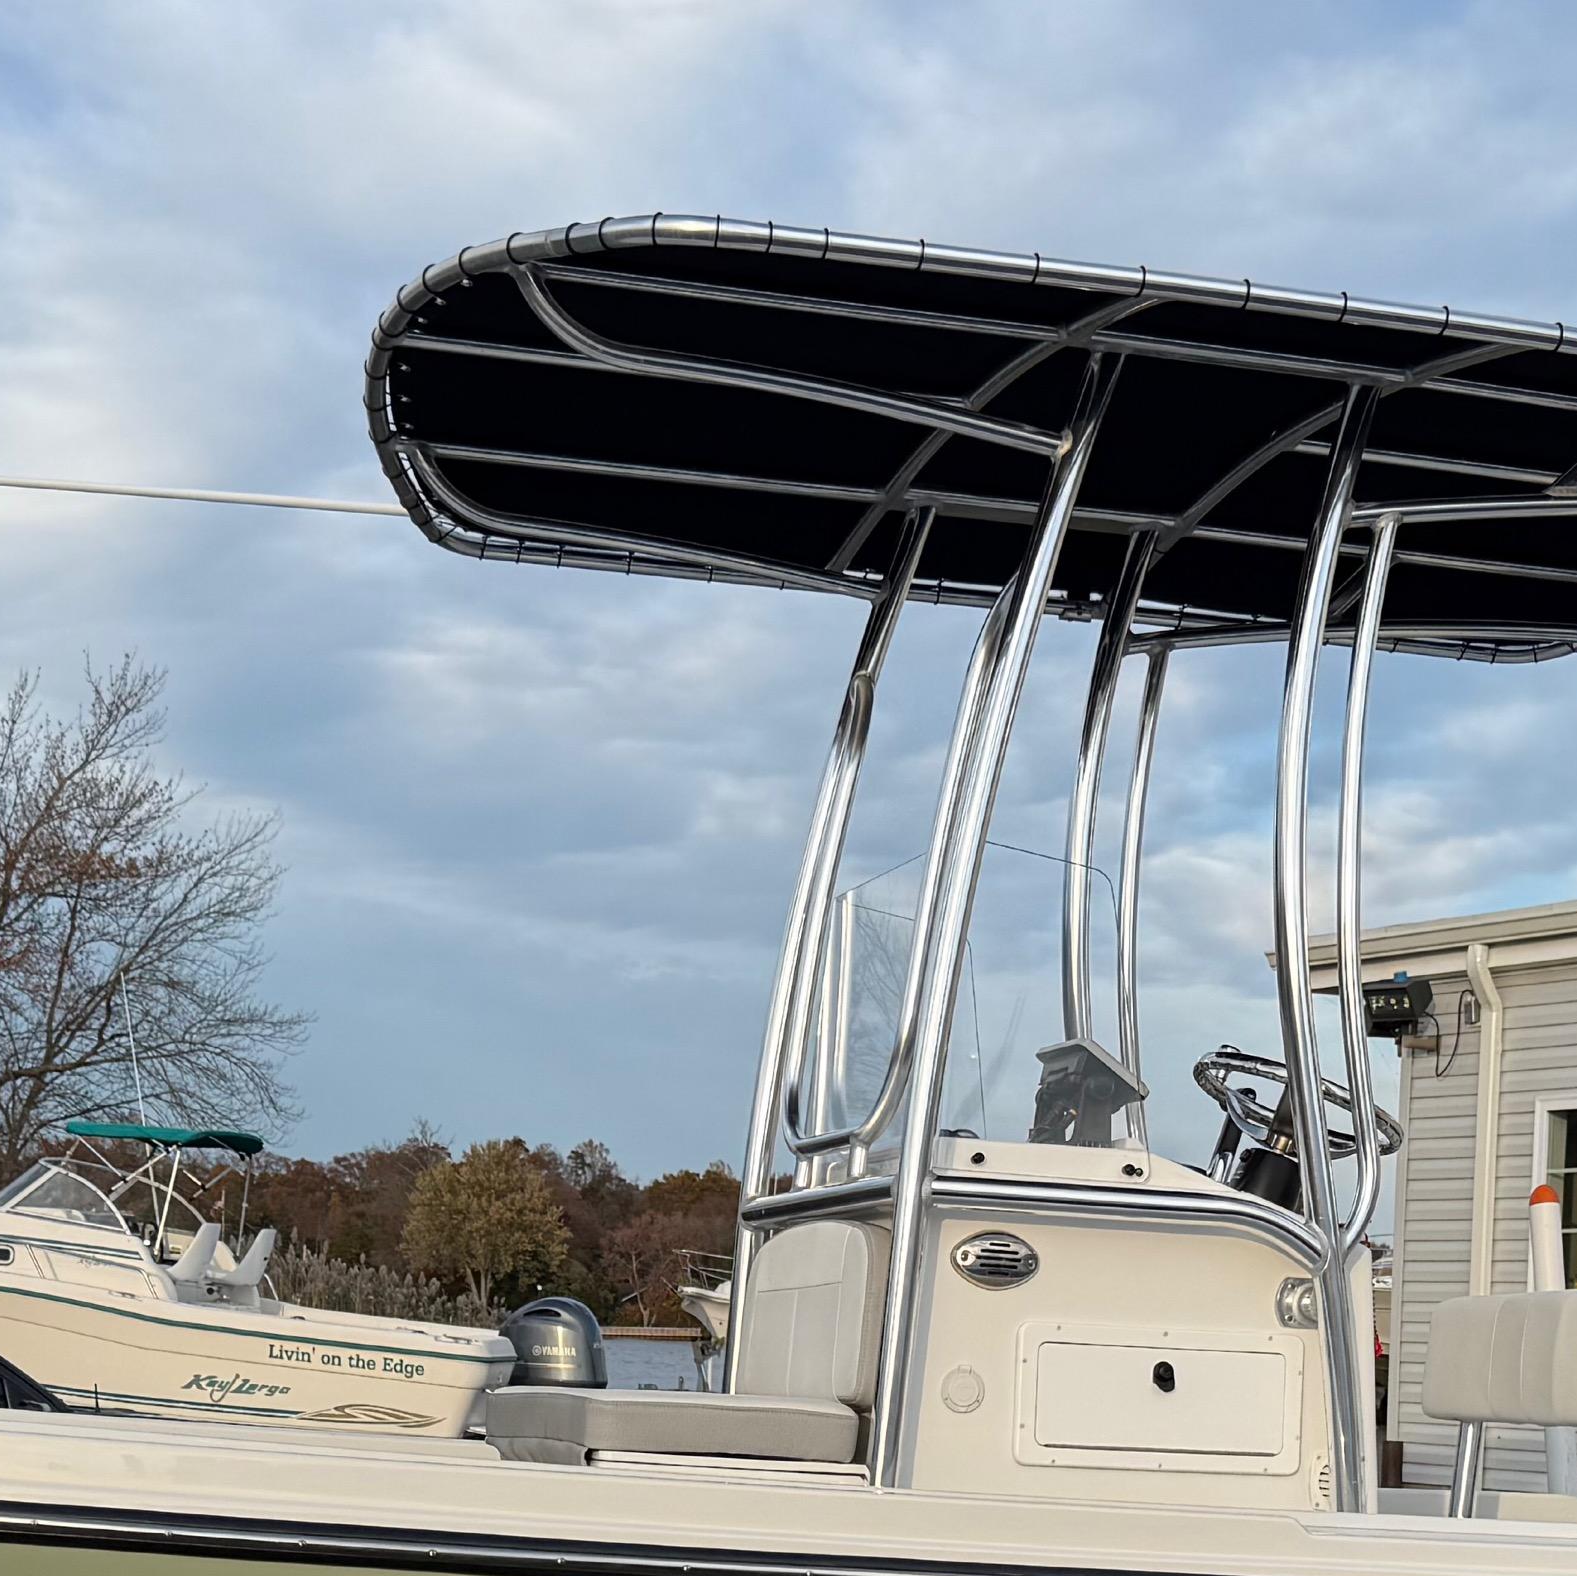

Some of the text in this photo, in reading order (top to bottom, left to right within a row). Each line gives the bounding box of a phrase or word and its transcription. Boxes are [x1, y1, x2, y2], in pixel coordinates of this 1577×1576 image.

[268, 1344, 425, 1378] Livin' on the Edge
